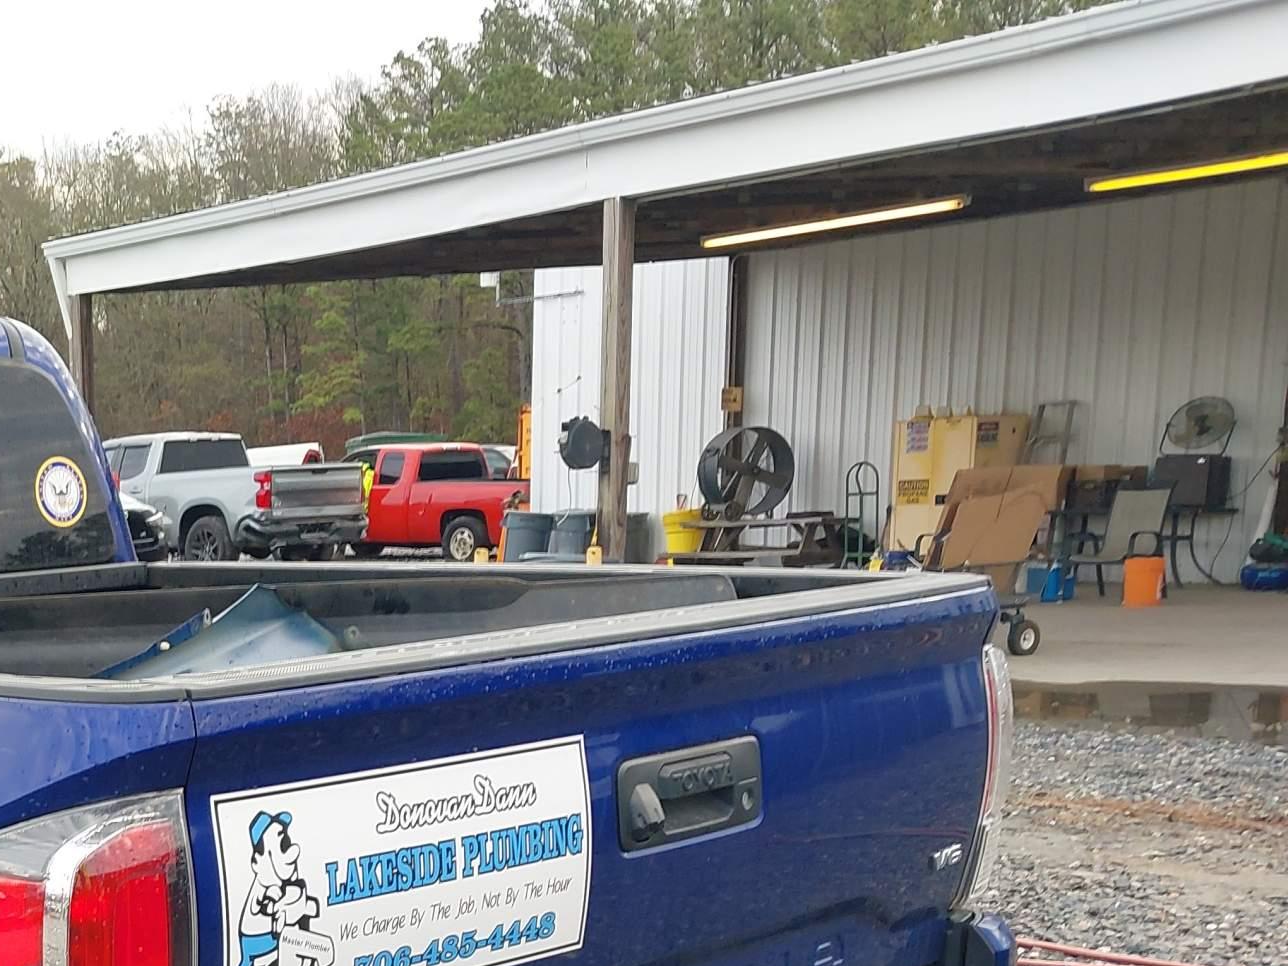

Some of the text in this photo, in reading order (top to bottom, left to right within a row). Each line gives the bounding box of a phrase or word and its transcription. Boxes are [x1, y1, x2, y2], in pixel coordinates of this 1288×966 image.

[899, 481, 929, 490] CAUTION
[673, 762, 732, 792] TOYOTA
[326, 813, 583, 906] LAKESIDE PLUMBING
[340, 876, 573, 941] We Charge By The Job, Not By The Hour
